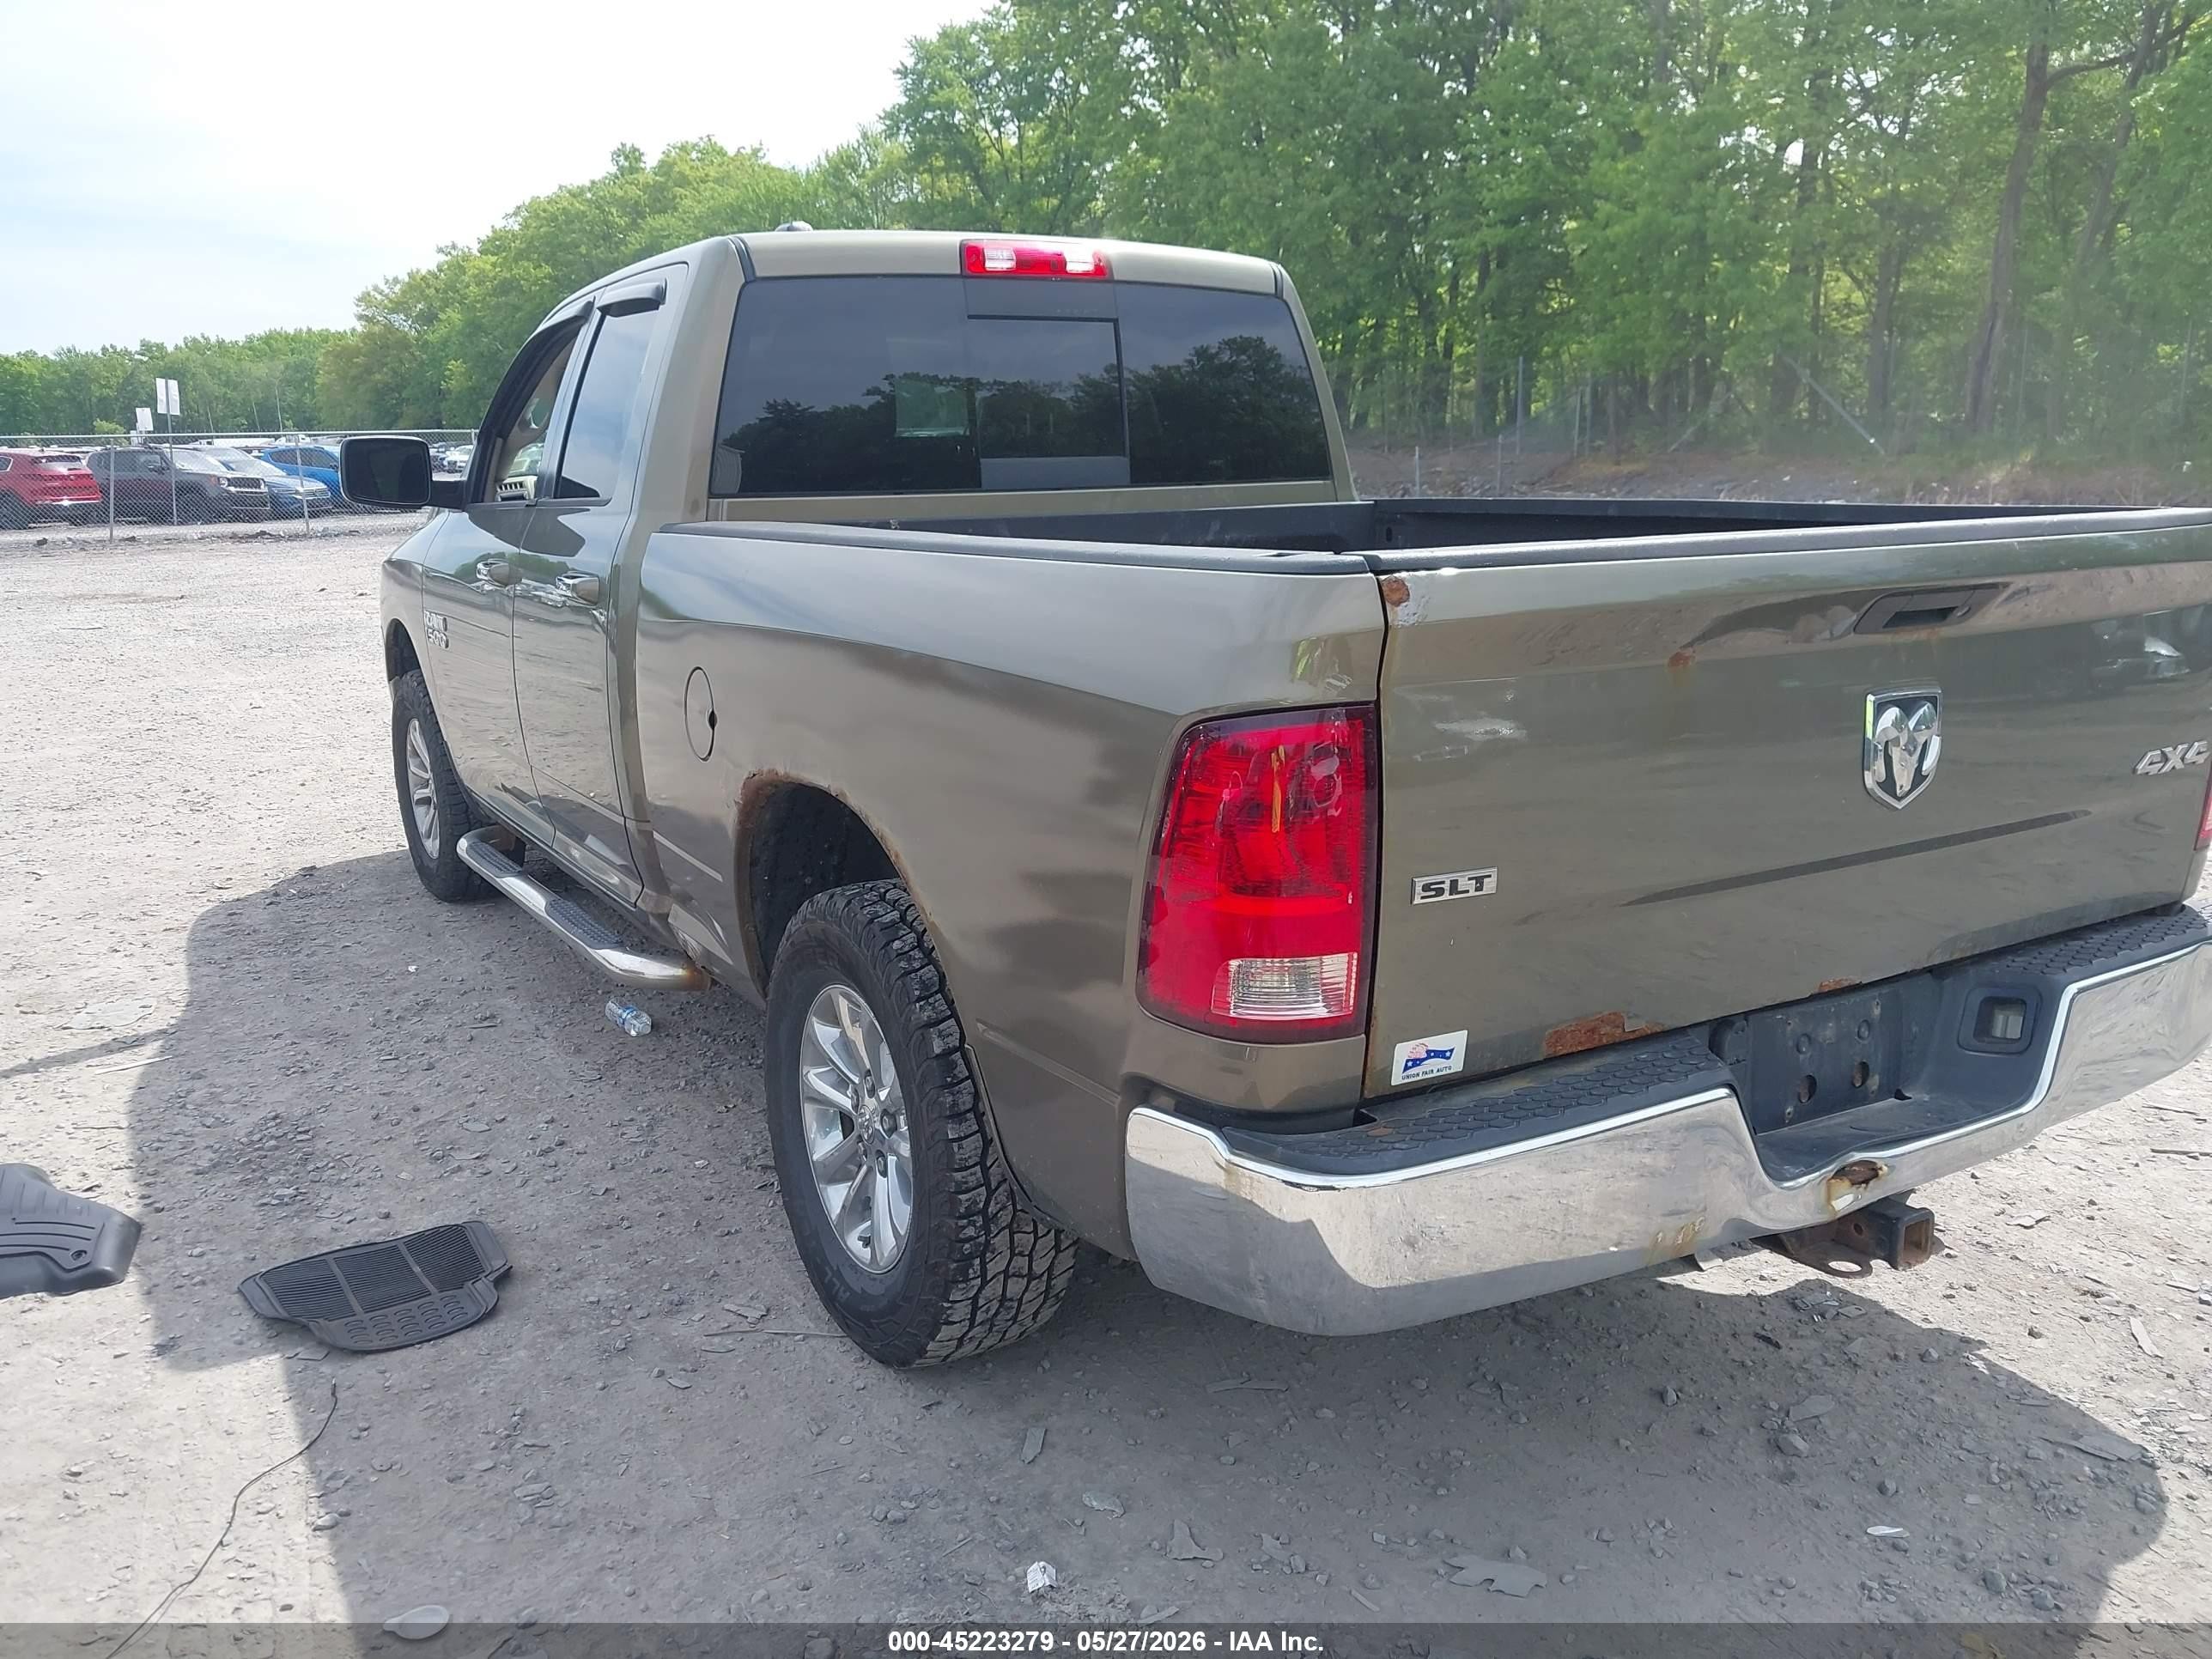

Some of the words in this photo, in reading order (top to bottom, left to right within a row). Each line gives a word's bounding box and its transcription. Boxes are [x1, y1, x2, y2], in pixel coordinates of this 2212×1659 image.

[2136, 740, 2210, 776] 4X4
[1419, 873, 1492, 901] SLT
[1401, 1072, 1420, 1080] UNION
[1421, 1069, 1434, 1078] FAIR
[1436, 1065, 1452, 1073] AUTO
